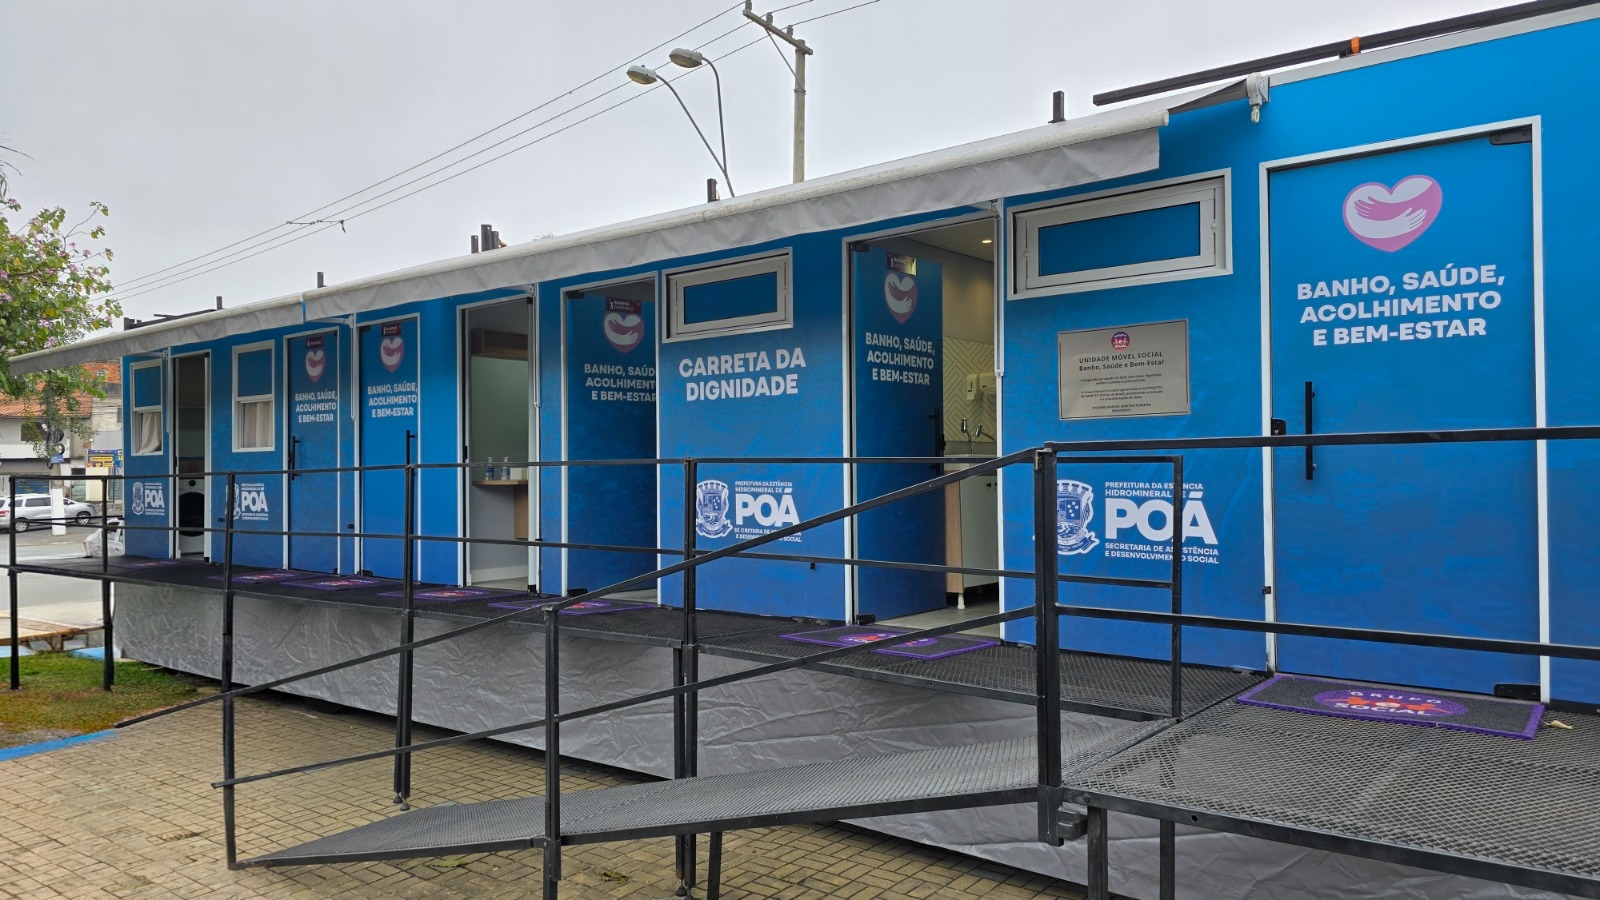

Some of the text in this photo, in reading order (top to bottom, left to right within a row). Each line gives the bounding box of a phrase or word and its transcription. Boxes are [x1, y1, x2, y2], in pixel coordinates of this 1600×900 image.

[1297, 262, 1505, 300] BANHO, SAÚDE,
[1300, 290, 1502, 324] ACOLHIMENTO
[1313, 318, 1487, 346] E BEM-ESTAR
[865, 332, 935, 356] BANHO, SAÚDE,
[679, 347, 806, 378] CARRETA DA
[867, 350, 934, 370] ACOLHIMENTO
[1078, 351, 1163, 364] UNIDADE MÓVEL SOCIAL
[584, 363, 655, 377] BANHO, SAÚD
[1079, 363, 1102, 372] Banho,
[1102, 361, 1123, 370] Saúde
[585, 377, 656, 390] ACOLHIMENT
[872, 368, 930, 386] E BEM-ESTAR
[367, 380, 418, 395] BANHO, SAÚDE,
[686, 373, 799, 401] DIGNIDADE
[368, 394, 418, 406] ACOLHIMENTO
[591, 390, 599, 400] E
[296, 402, 337, 412] ACOLHIMENTO
[371, 407, 414, 418] E BEM-ESTAR
[298, 413, 334, 423] E BEM-ESTAR
[1105, 481, 1204, 490] PREFEITURA DA ESNCIA
[1105, 489, 1173, 498] HIDROMINERAL
[735, 487, 800, 527] POÁ
[1105, 491, 1219, 545] POÁ
[1104, 542, 1151, 552] SECRETARIA
[1165, 545, 1219, 556] ASSTÊNCIA
[1111, 551, 1186, 562] DESENVOLVIMENO
[1187, 555, 1219, 564] SOCIAL
[1334, 702, 1432, 715] SOCIAL
